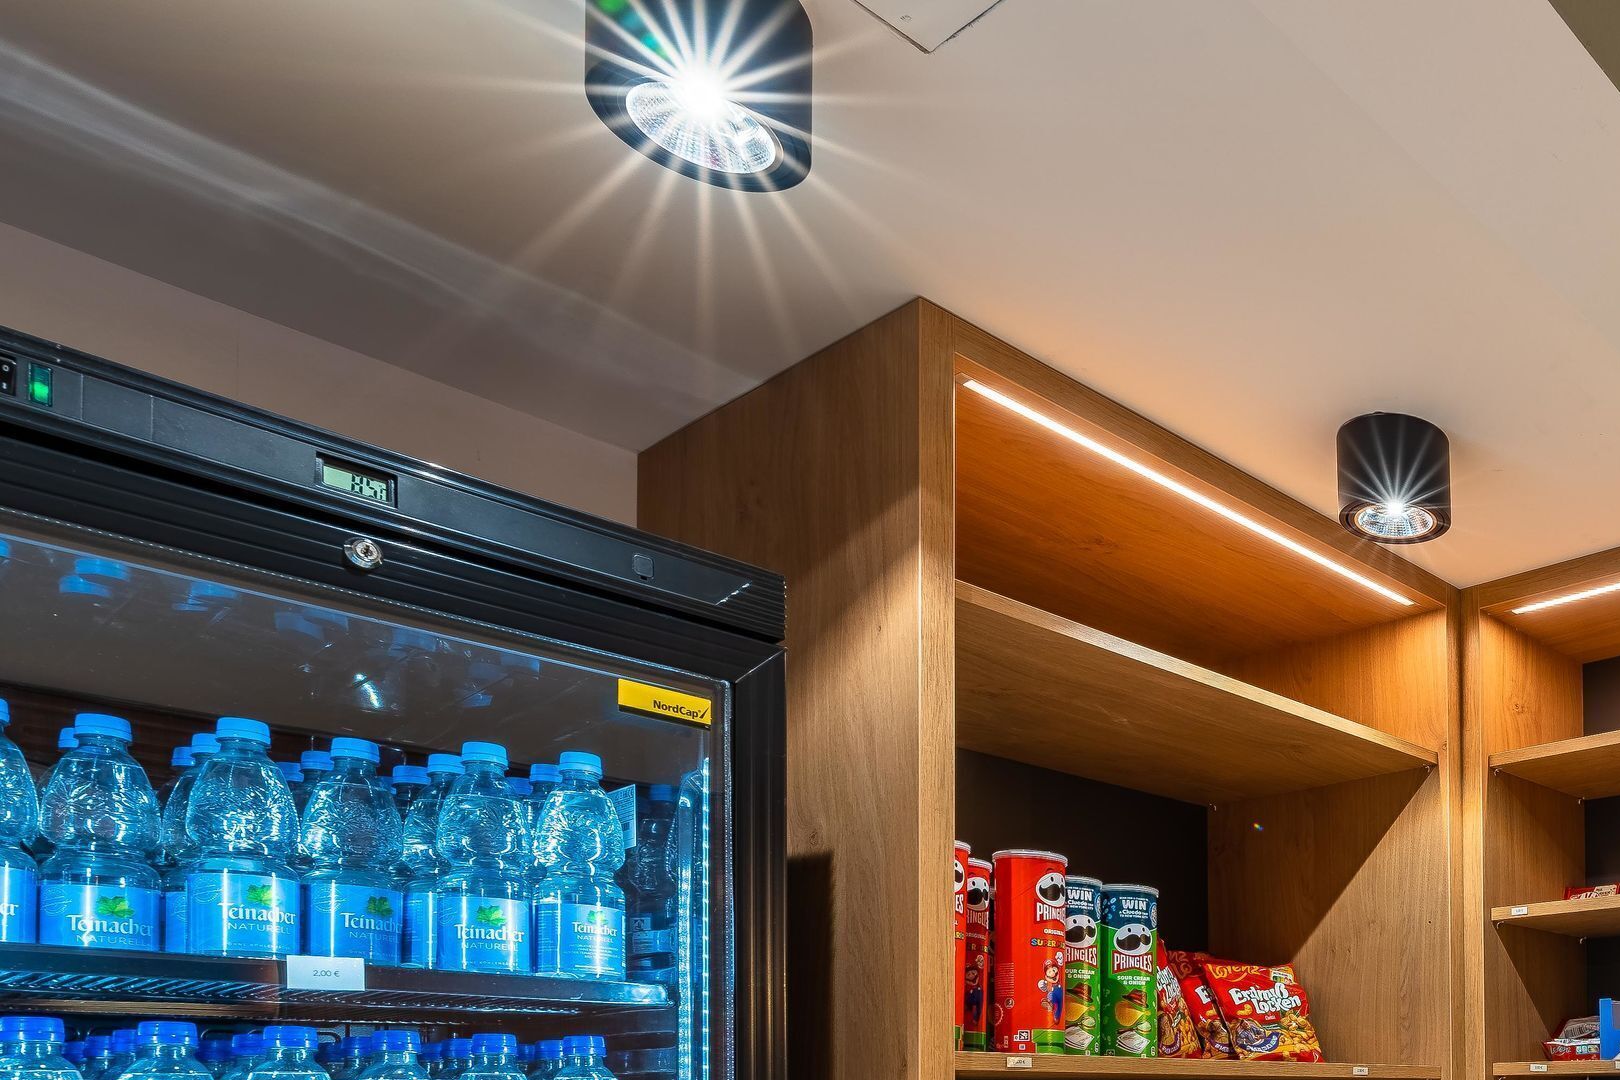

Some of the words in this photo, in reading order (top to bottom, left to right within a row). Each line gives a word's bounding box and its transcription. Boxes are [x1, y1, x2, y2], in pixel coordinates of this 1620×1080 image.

[653, 699, 698, 719] NordCap
[1067, 889, 1093, 902] WIN
[1121, 899, 1147, 911] WIN
[218, 902, 297, 926] Teinacher
[66, 914, 153, 937] Teinacher
[454, 924, 525, 943] Teinacher
[1113, 952, 1153, 973] PRINGLES
[333, 970, 341, 978] €
[1251, 994, 1302, 1014] Locken
